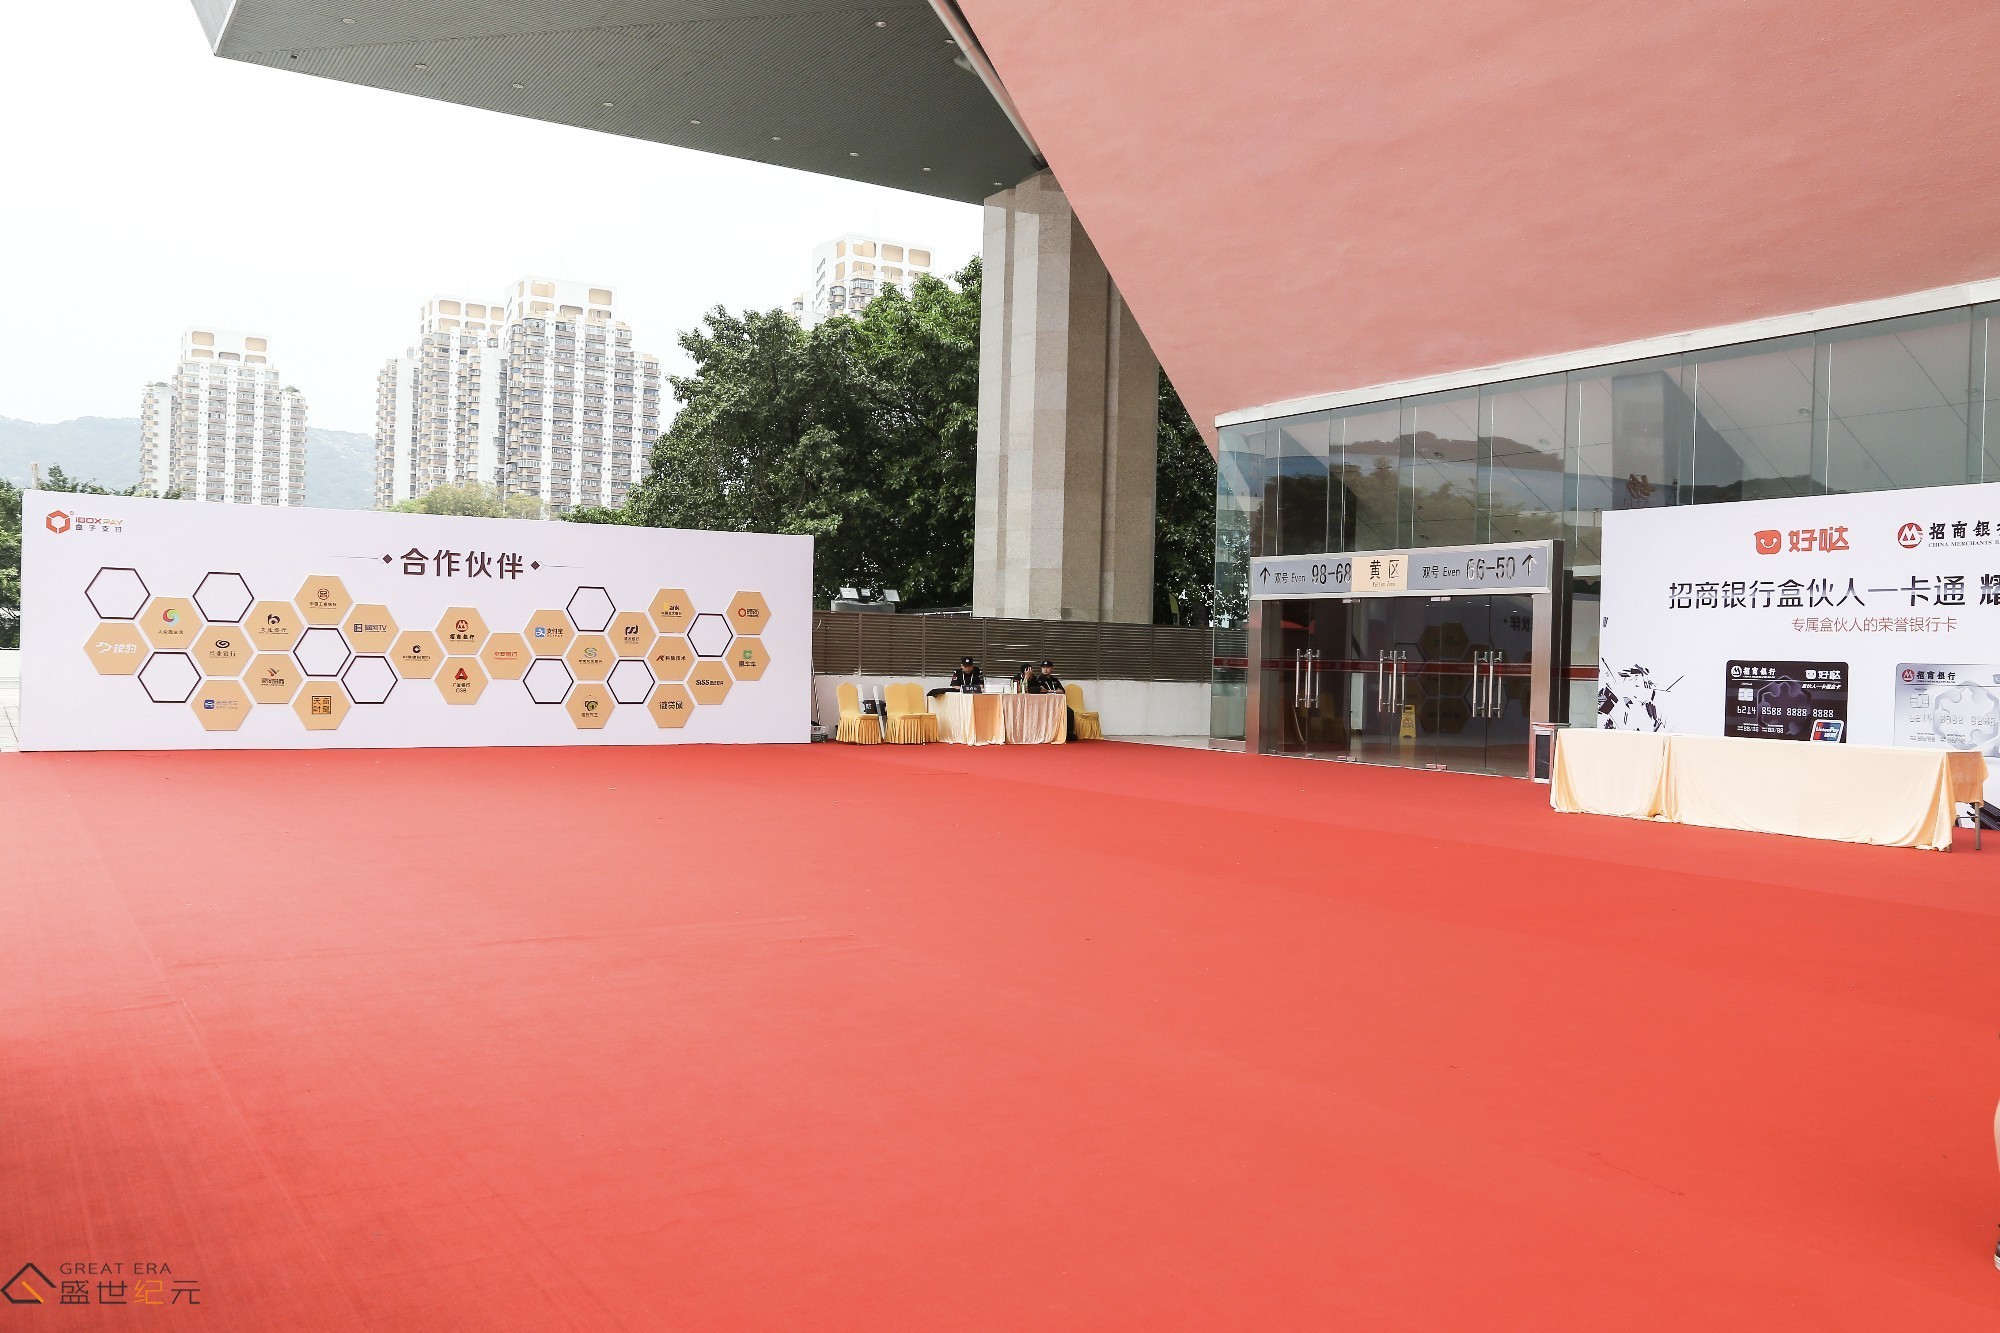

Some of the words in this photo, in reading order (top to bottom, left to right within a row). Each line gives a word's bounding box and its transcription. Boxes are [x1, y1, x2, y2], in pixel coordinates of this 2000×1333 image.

[1788, 525, 1850, 554] 好哒
[400, 547, 524, 580] 合作伙伴
[1369, 559, 1400, 580] 黄区
[1422, 565, 1440, 579] 双号
[1442, 566, 1461, 577] Even
[1466, 556, 1516, 580] 66-50
[1291, 573, 1306, 583] Even
[1311, 562, 1352, 584] 98-68
[1668, 574, 1966, 610] 招商银行盒伙人一卡通
[546, 627, 564, 635] 支付宝
[1791, 616, 1958, 633] 专属盒伙人的荣誉银行卡
[113, 643, 137, 654] 银豹
[1743, 666, 1777, 676] 招商银行
[1817, 670, 1842, 680] 好哒
[1916, 670, 1956, 681] 招商银行
[1737, 705, 1757, 715] 6214
[1761, 706, 1782, 716] 8588
[1786, 707, 1808, 717] 8888
[1812, 708, 1834, 718] 8888
